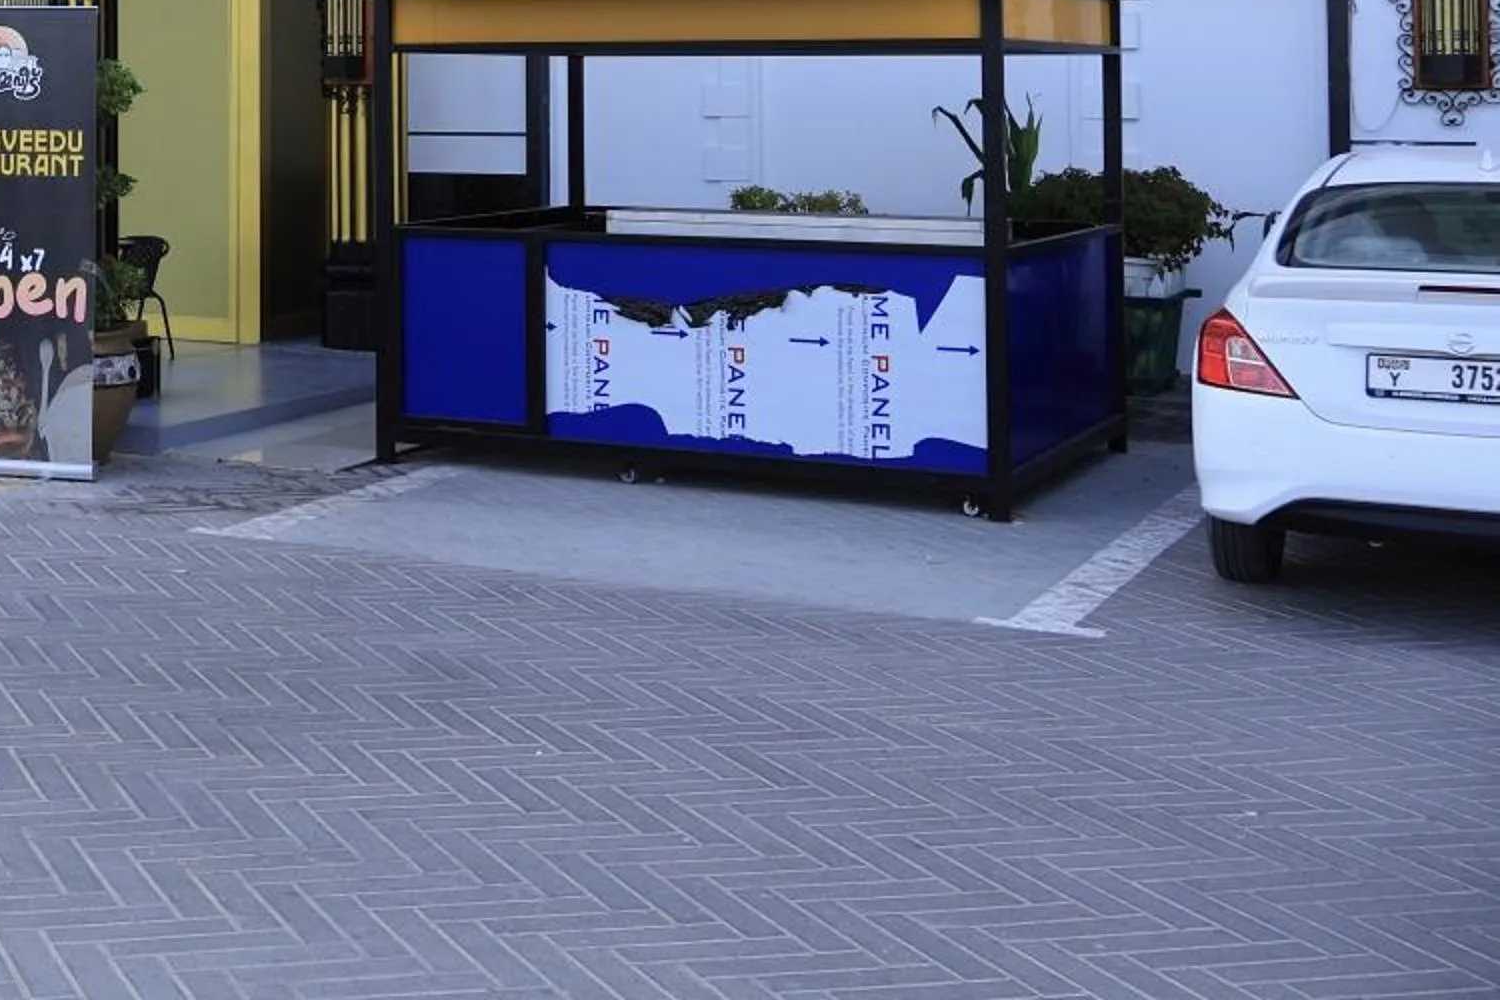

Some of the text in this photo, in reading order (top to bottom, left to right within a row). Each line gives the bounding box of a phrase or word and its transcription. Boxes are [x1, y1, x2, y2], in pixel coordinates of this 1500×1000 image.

[593, 339, 610, 414] PANE
[871, 355, 891, 460] PANEL
[1389, 372, 1401, 387] Y
